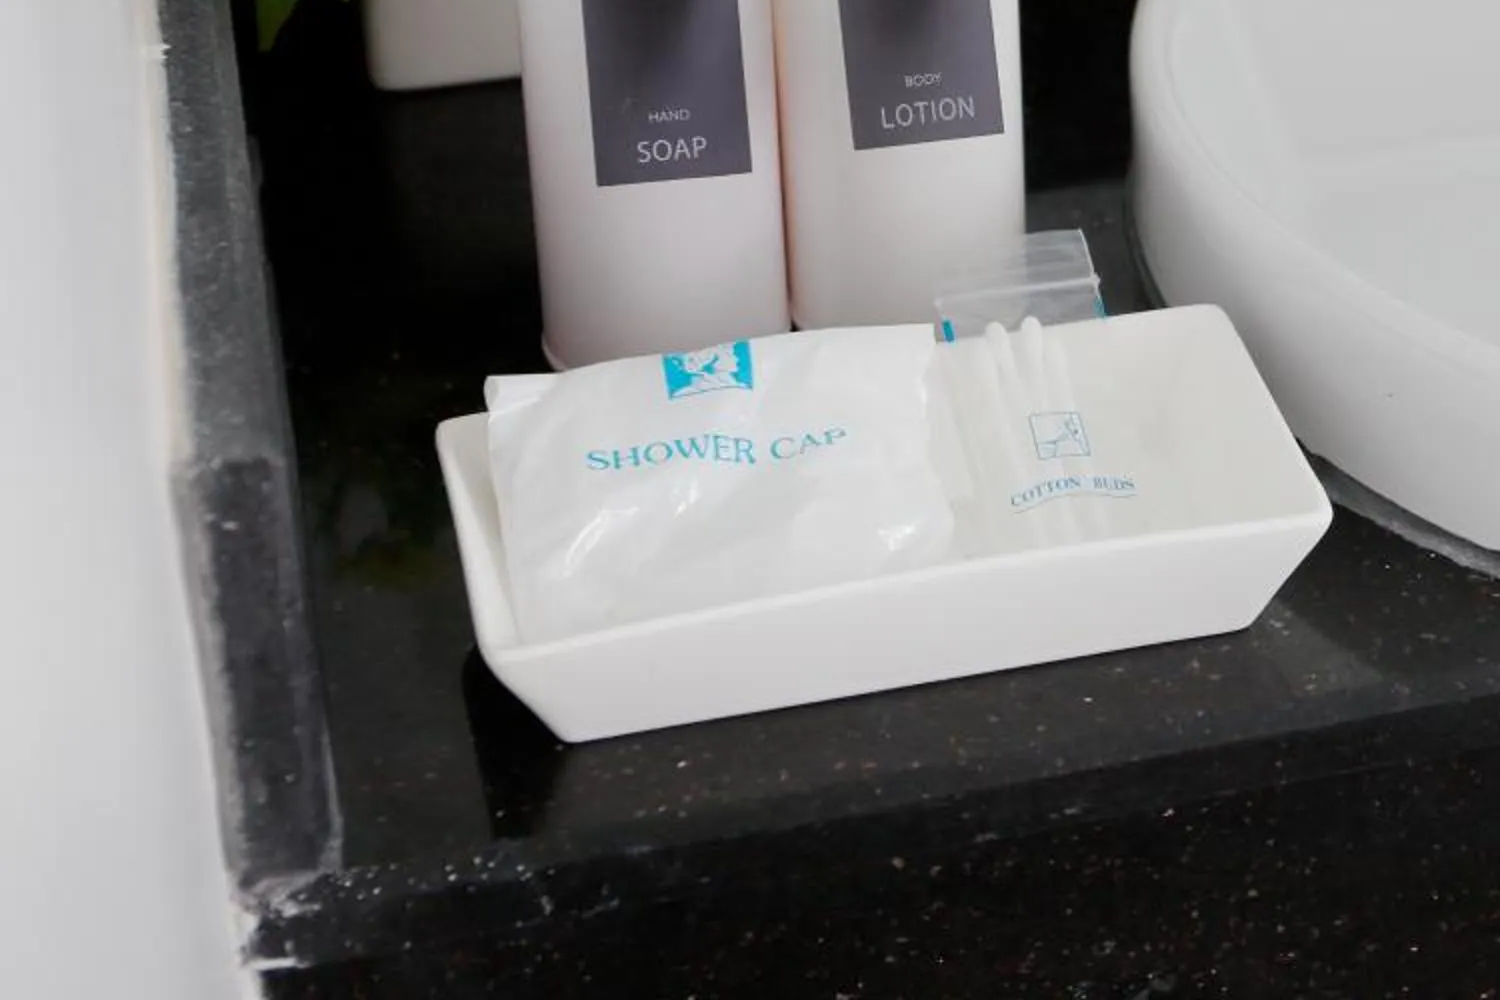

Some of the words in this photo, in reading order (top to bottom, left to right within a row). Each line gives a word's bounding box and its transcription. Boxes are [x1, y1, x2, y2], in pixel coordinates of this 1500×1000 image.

[905, 71, 942, 88] BODY
[648, 107, 691, 124] HAND
[880, 96, 976, 130] LOTION
[636, 135, 708, 165] SOAP
[585, 433, 757, 472] SHOWER
[769, 426, 850, 460] CAP
[1010, 476, 1082, 507] COTTON
[1093, 476, 1136, 491] BUDS
